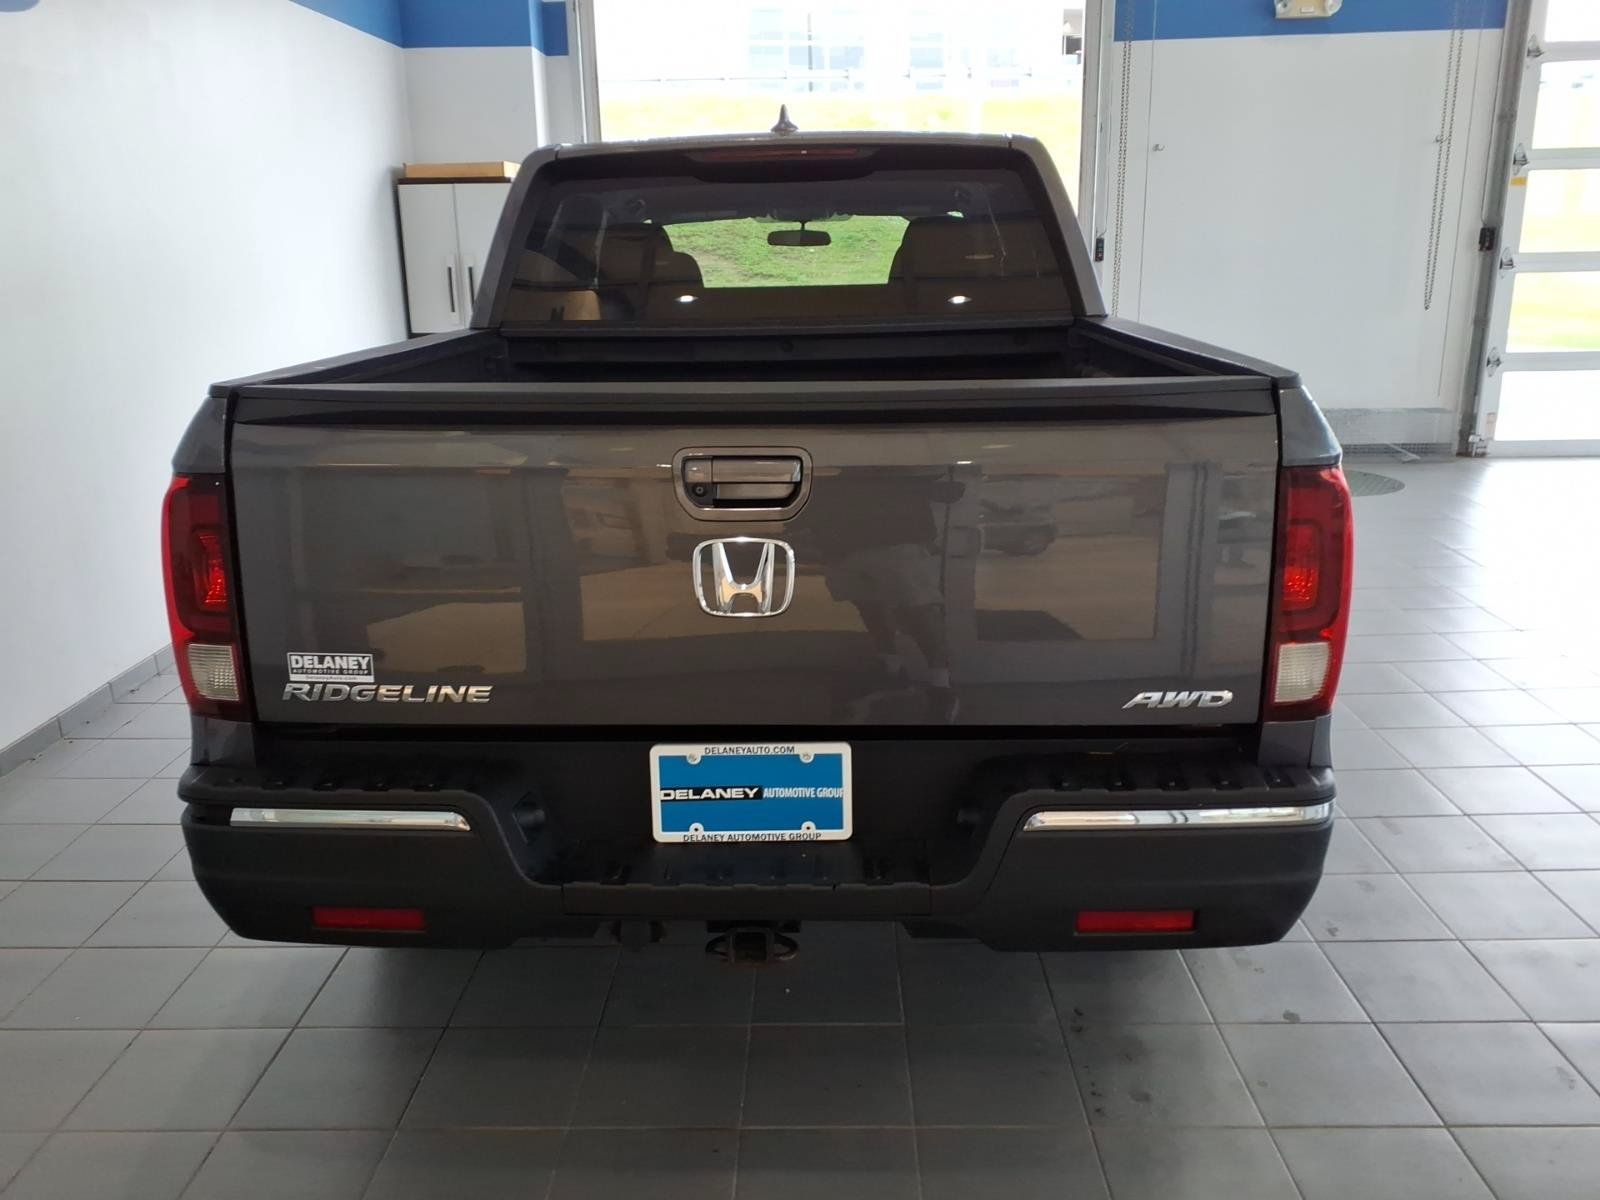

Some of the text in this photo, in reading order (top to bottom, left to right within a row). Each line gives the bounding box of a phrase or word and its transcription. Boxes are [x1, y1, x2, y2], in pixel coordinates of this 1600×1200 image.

[290, 655, 370, 669] DELANEY
[282, 683, 494, 703] RIDGELINE
[1121, 690, 1233, 708] AWD
[704, 746, 795, 755] DELANEYAUTO.COM
[660, 787, 759, 801] DELANEY
[763, 787, 816, 799] AUTOMOTIVE
[683, 832, 822, 843] DELANEY AUTOMOTIVE GROUP
